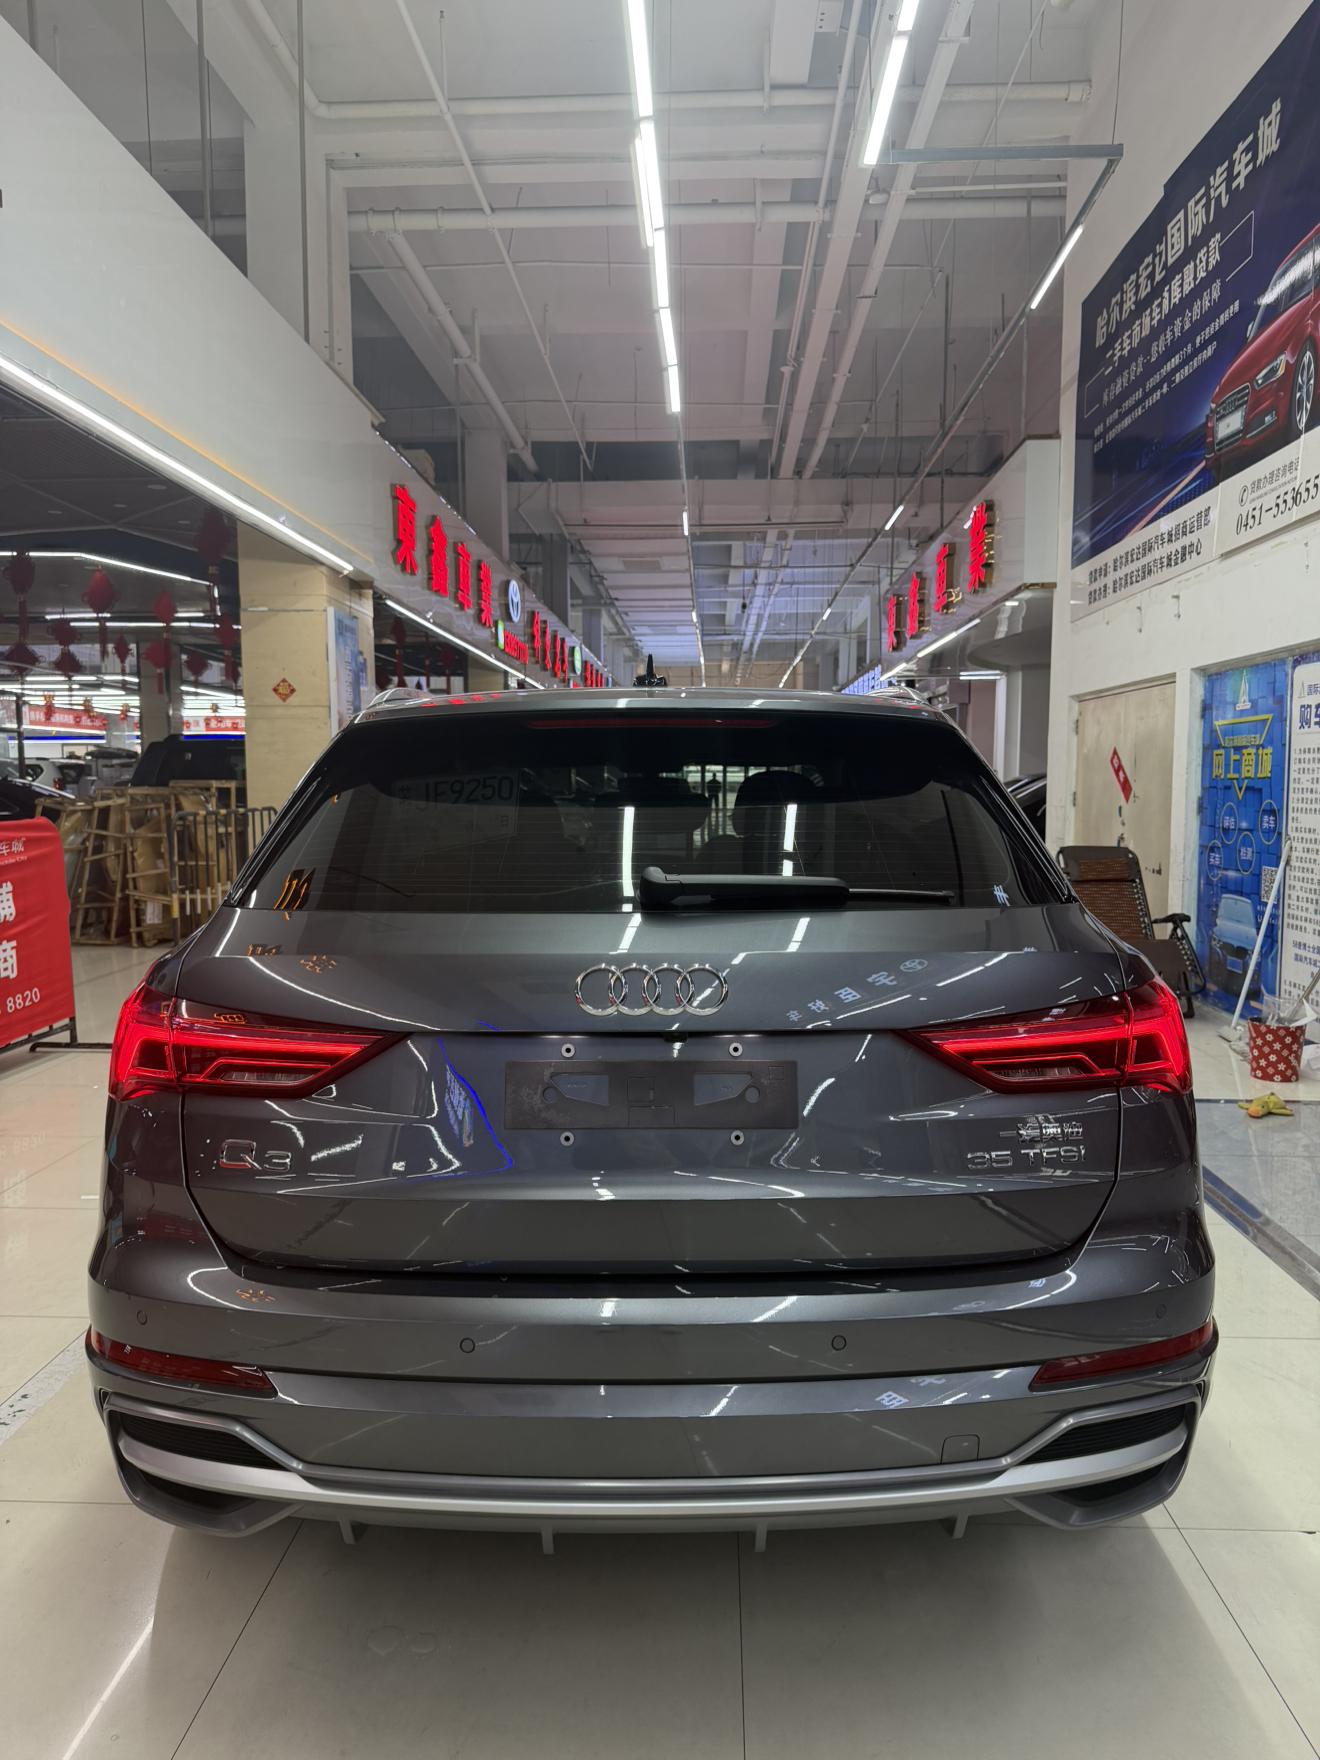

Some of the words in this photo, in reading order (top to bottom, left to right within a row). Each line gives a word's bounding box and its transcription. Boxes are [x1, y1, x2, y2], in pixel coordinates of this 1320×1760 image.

[1096, 97, 1281, 348] 哈尔滨宏达国际汽车城
[1212, 746, 1273, 780] 网上商城
[6, 987, 40, 1013] 8820
[219, 1138, 293, 1172] Q3
[967, 1151, 1013, 1170] 35
[1020, 1145, 1087, 1167] TFSI
